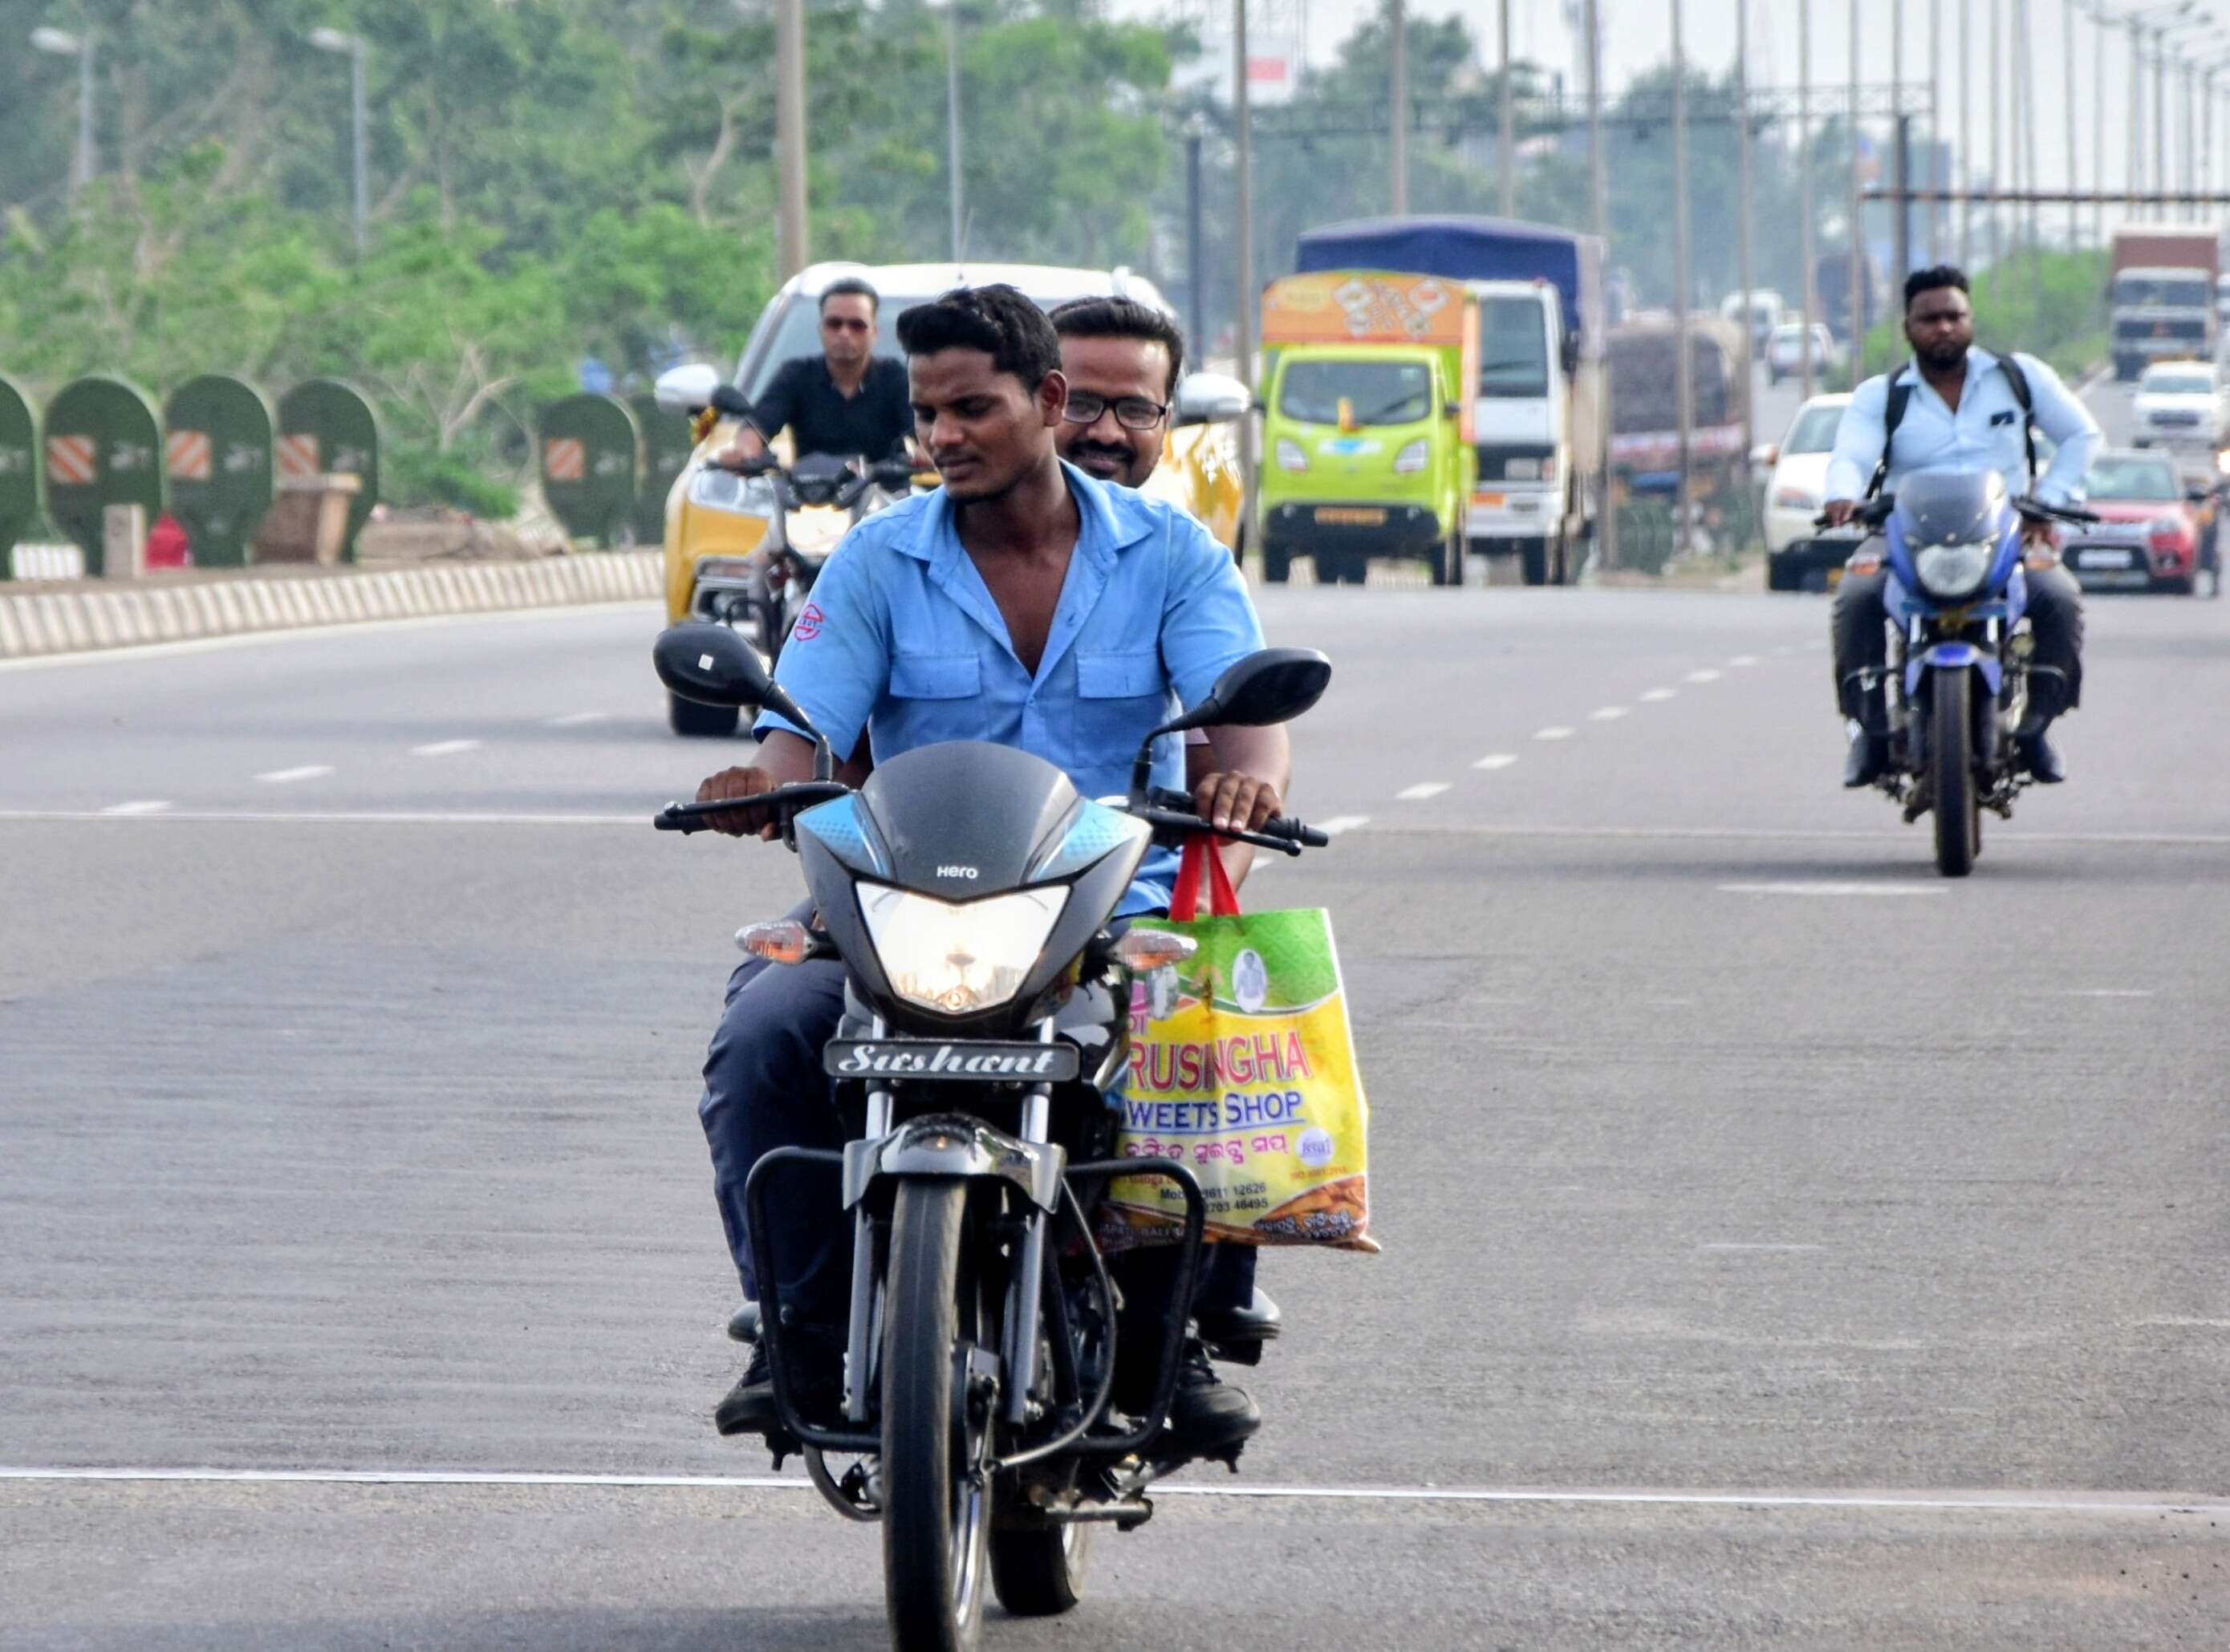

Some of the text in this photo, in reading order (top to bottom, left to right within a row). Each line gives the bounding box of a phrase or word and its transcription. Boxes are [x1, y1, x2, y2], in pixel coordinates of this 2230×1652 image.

[837, 1045, 1054, 1074] Sushant
[1122, 1092, 1302, 1129] WEETS SHOP
